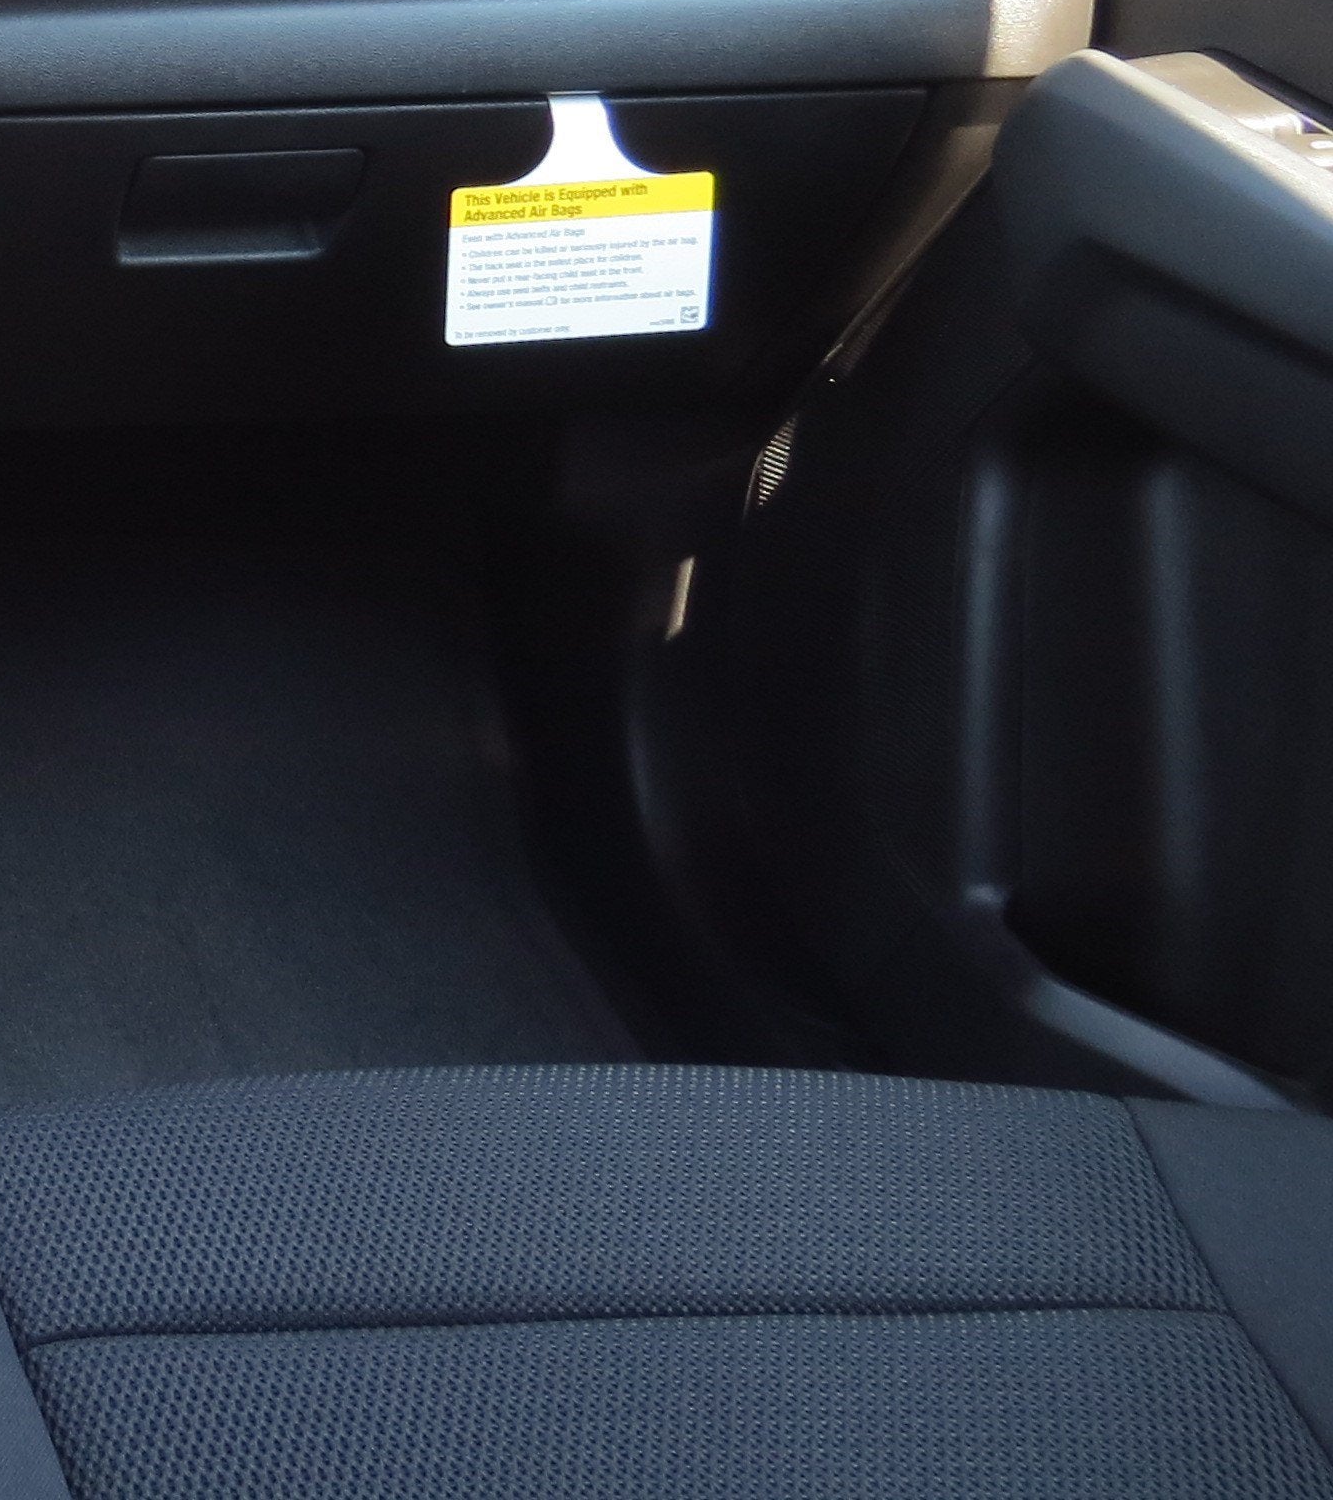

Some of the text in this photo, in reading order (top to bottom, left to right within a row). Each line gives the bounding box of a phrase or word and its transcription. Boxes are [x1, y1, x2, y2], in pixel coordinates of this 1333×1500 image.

[464, 183, 648, 207] This Vehicle is Equipped with
[464, 203, 583, 222] Advanced Air Bags
